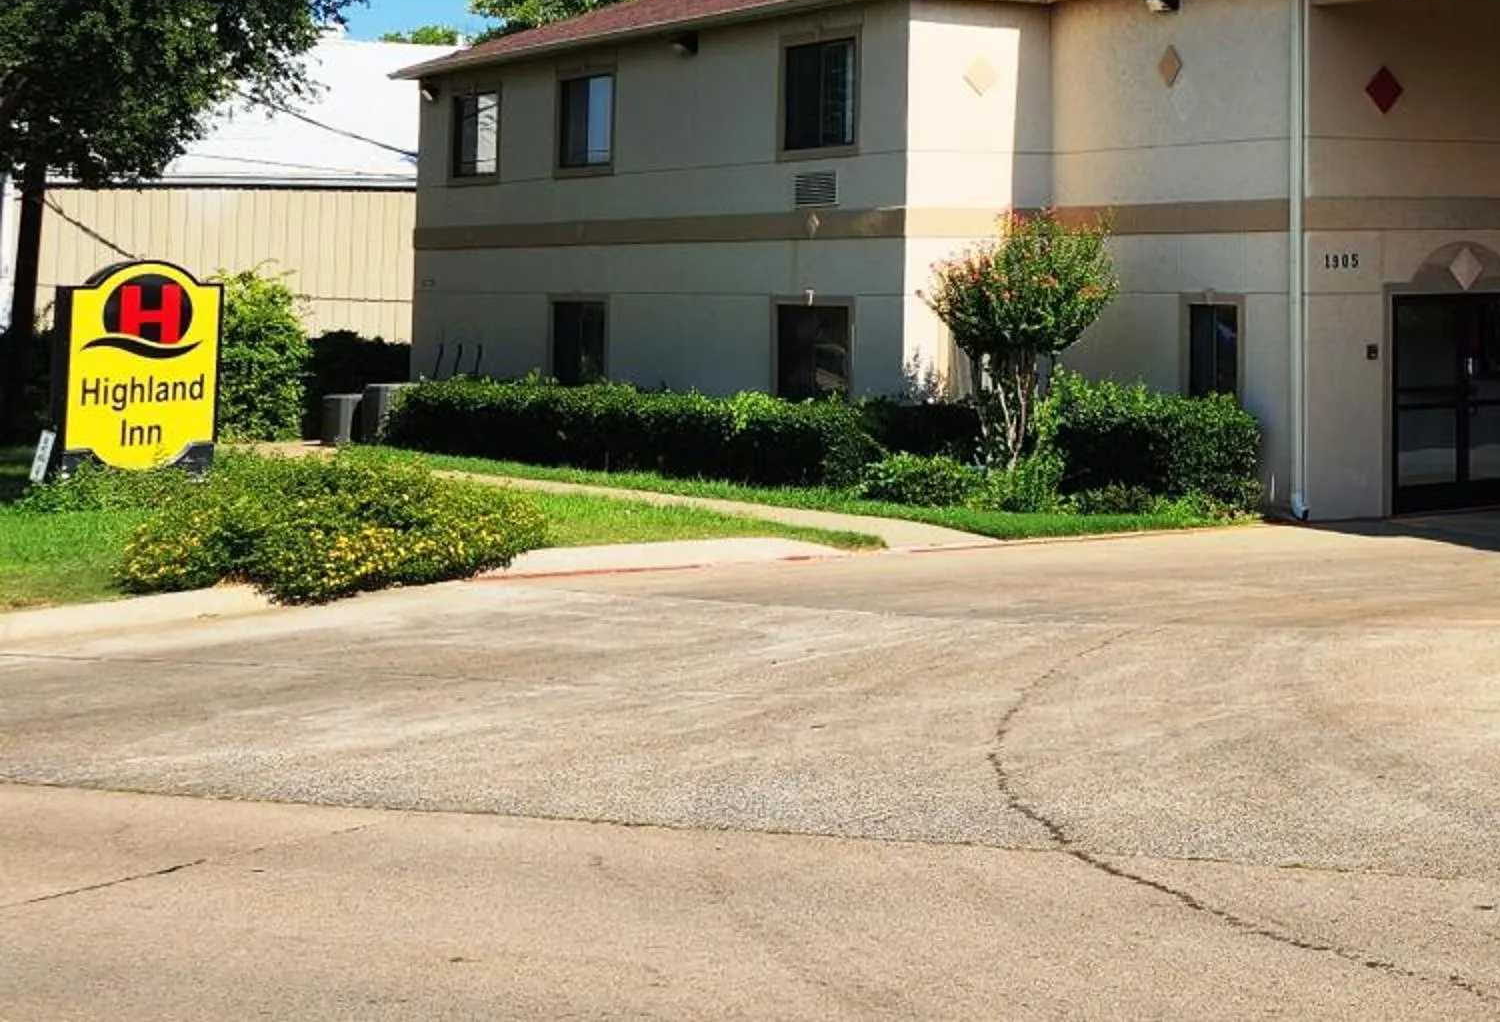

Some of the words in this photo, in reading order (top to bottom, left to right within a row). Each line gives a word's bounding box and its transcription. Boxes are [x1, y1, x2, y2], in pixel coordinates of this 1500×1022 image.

[120, 283, 182, 345] H
[80, 373, 205, 411] Highland
[120, 419, 162, 447] Inn
